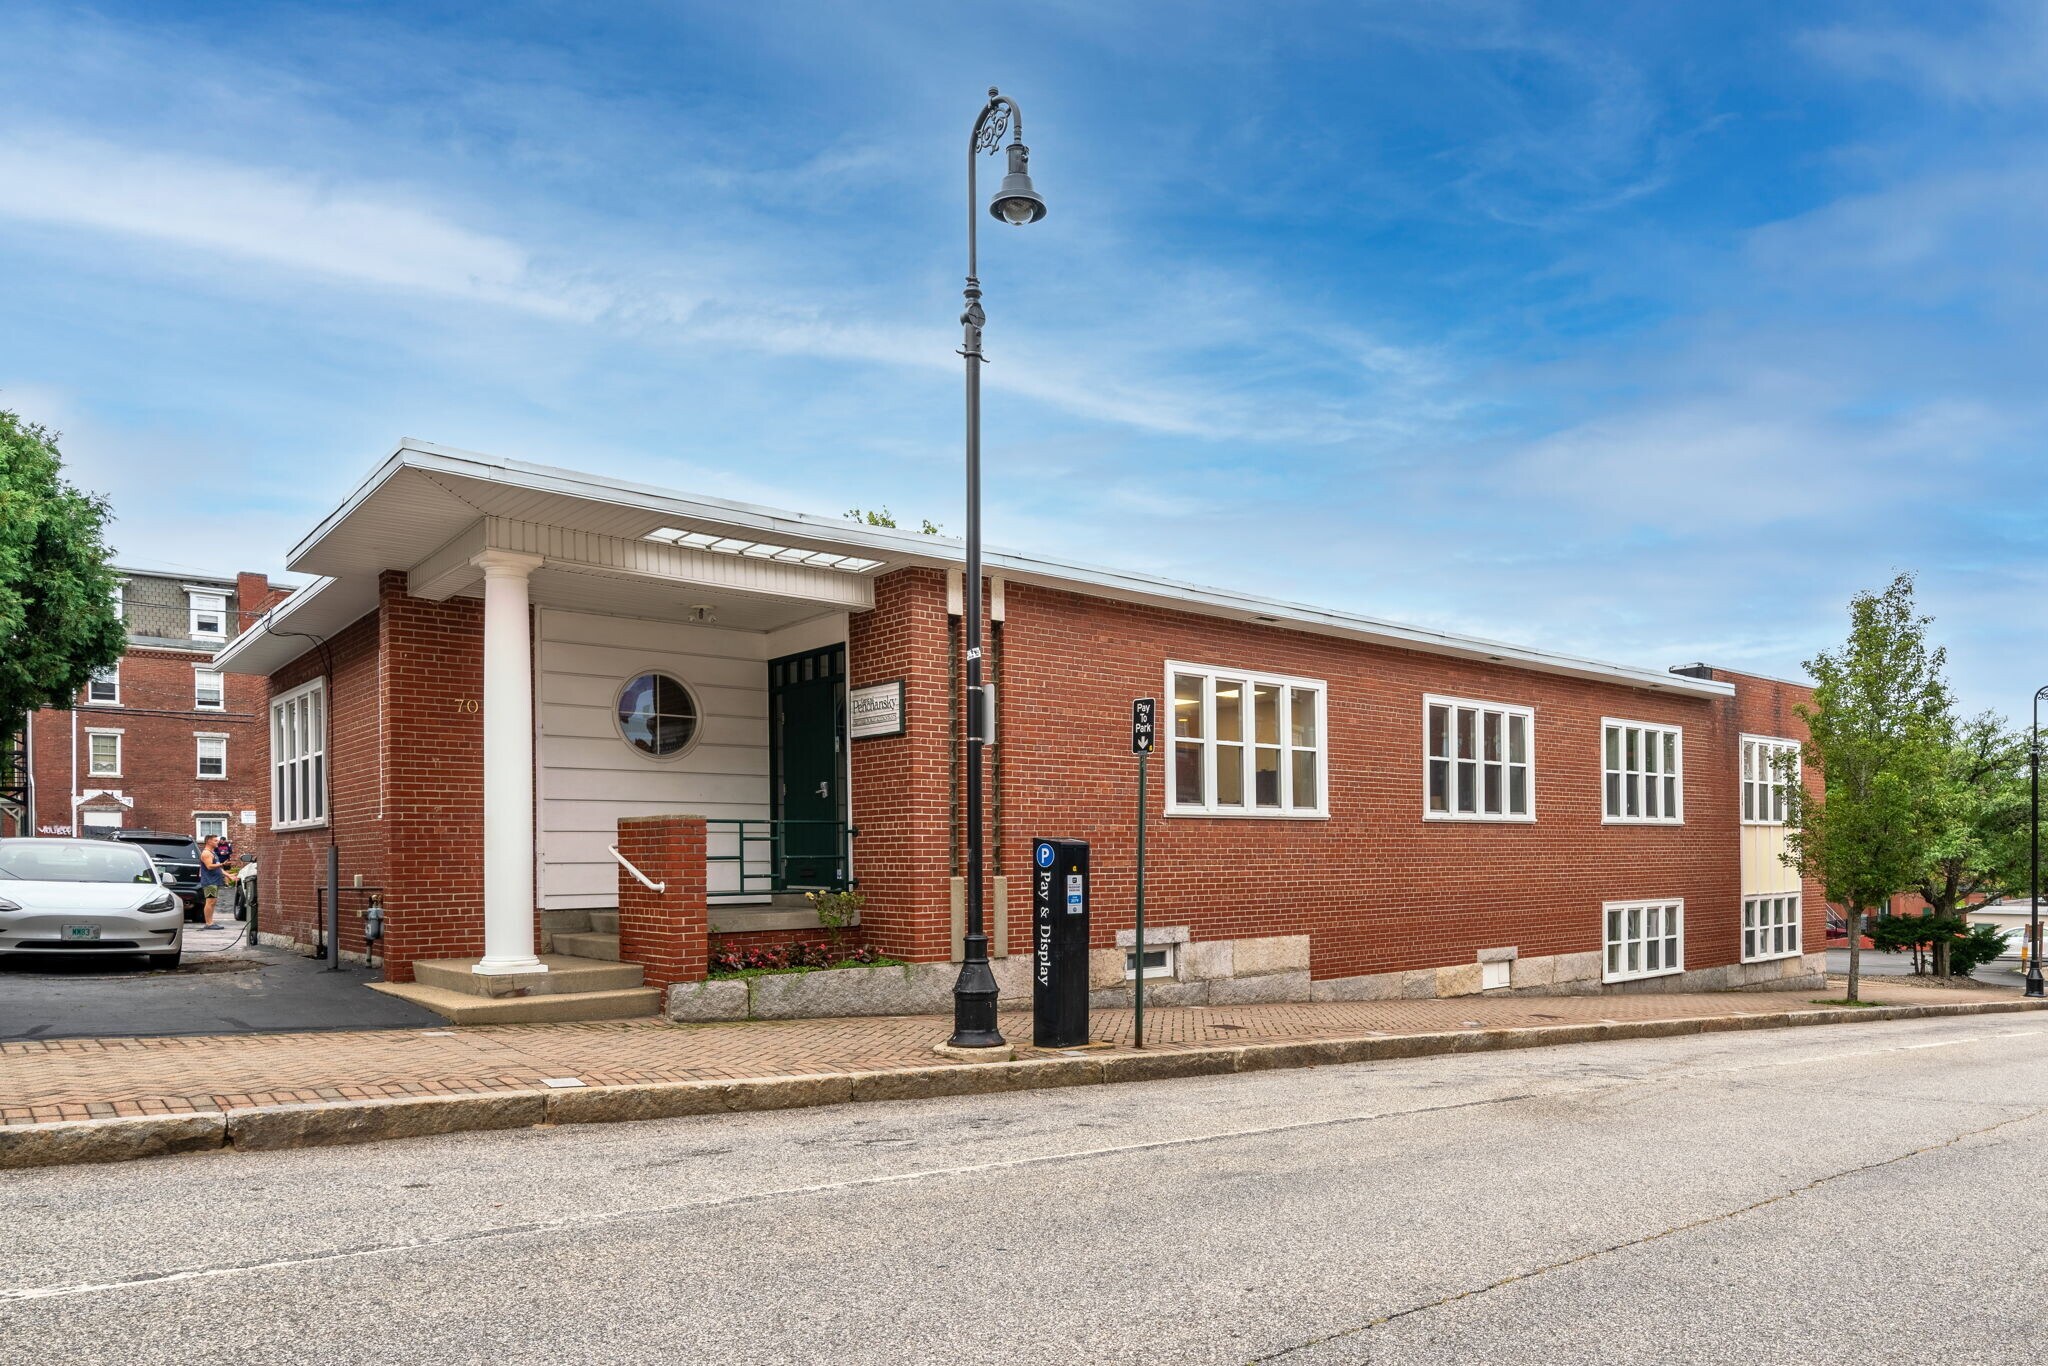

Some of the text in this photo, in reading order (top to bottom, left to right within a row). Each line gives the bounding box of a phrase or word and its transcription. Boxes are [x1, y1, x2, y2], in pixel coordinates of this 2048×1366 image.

[454, 698, 479, 714] 70
[1136, 703, 1151, 713] Pay
[1139, 713, 1148, 723] To
[1135, 723, 1152, 733] Park
[1041, 848, 1050, 864] P
[1037, 871, 1052, 987] Pay & Display
